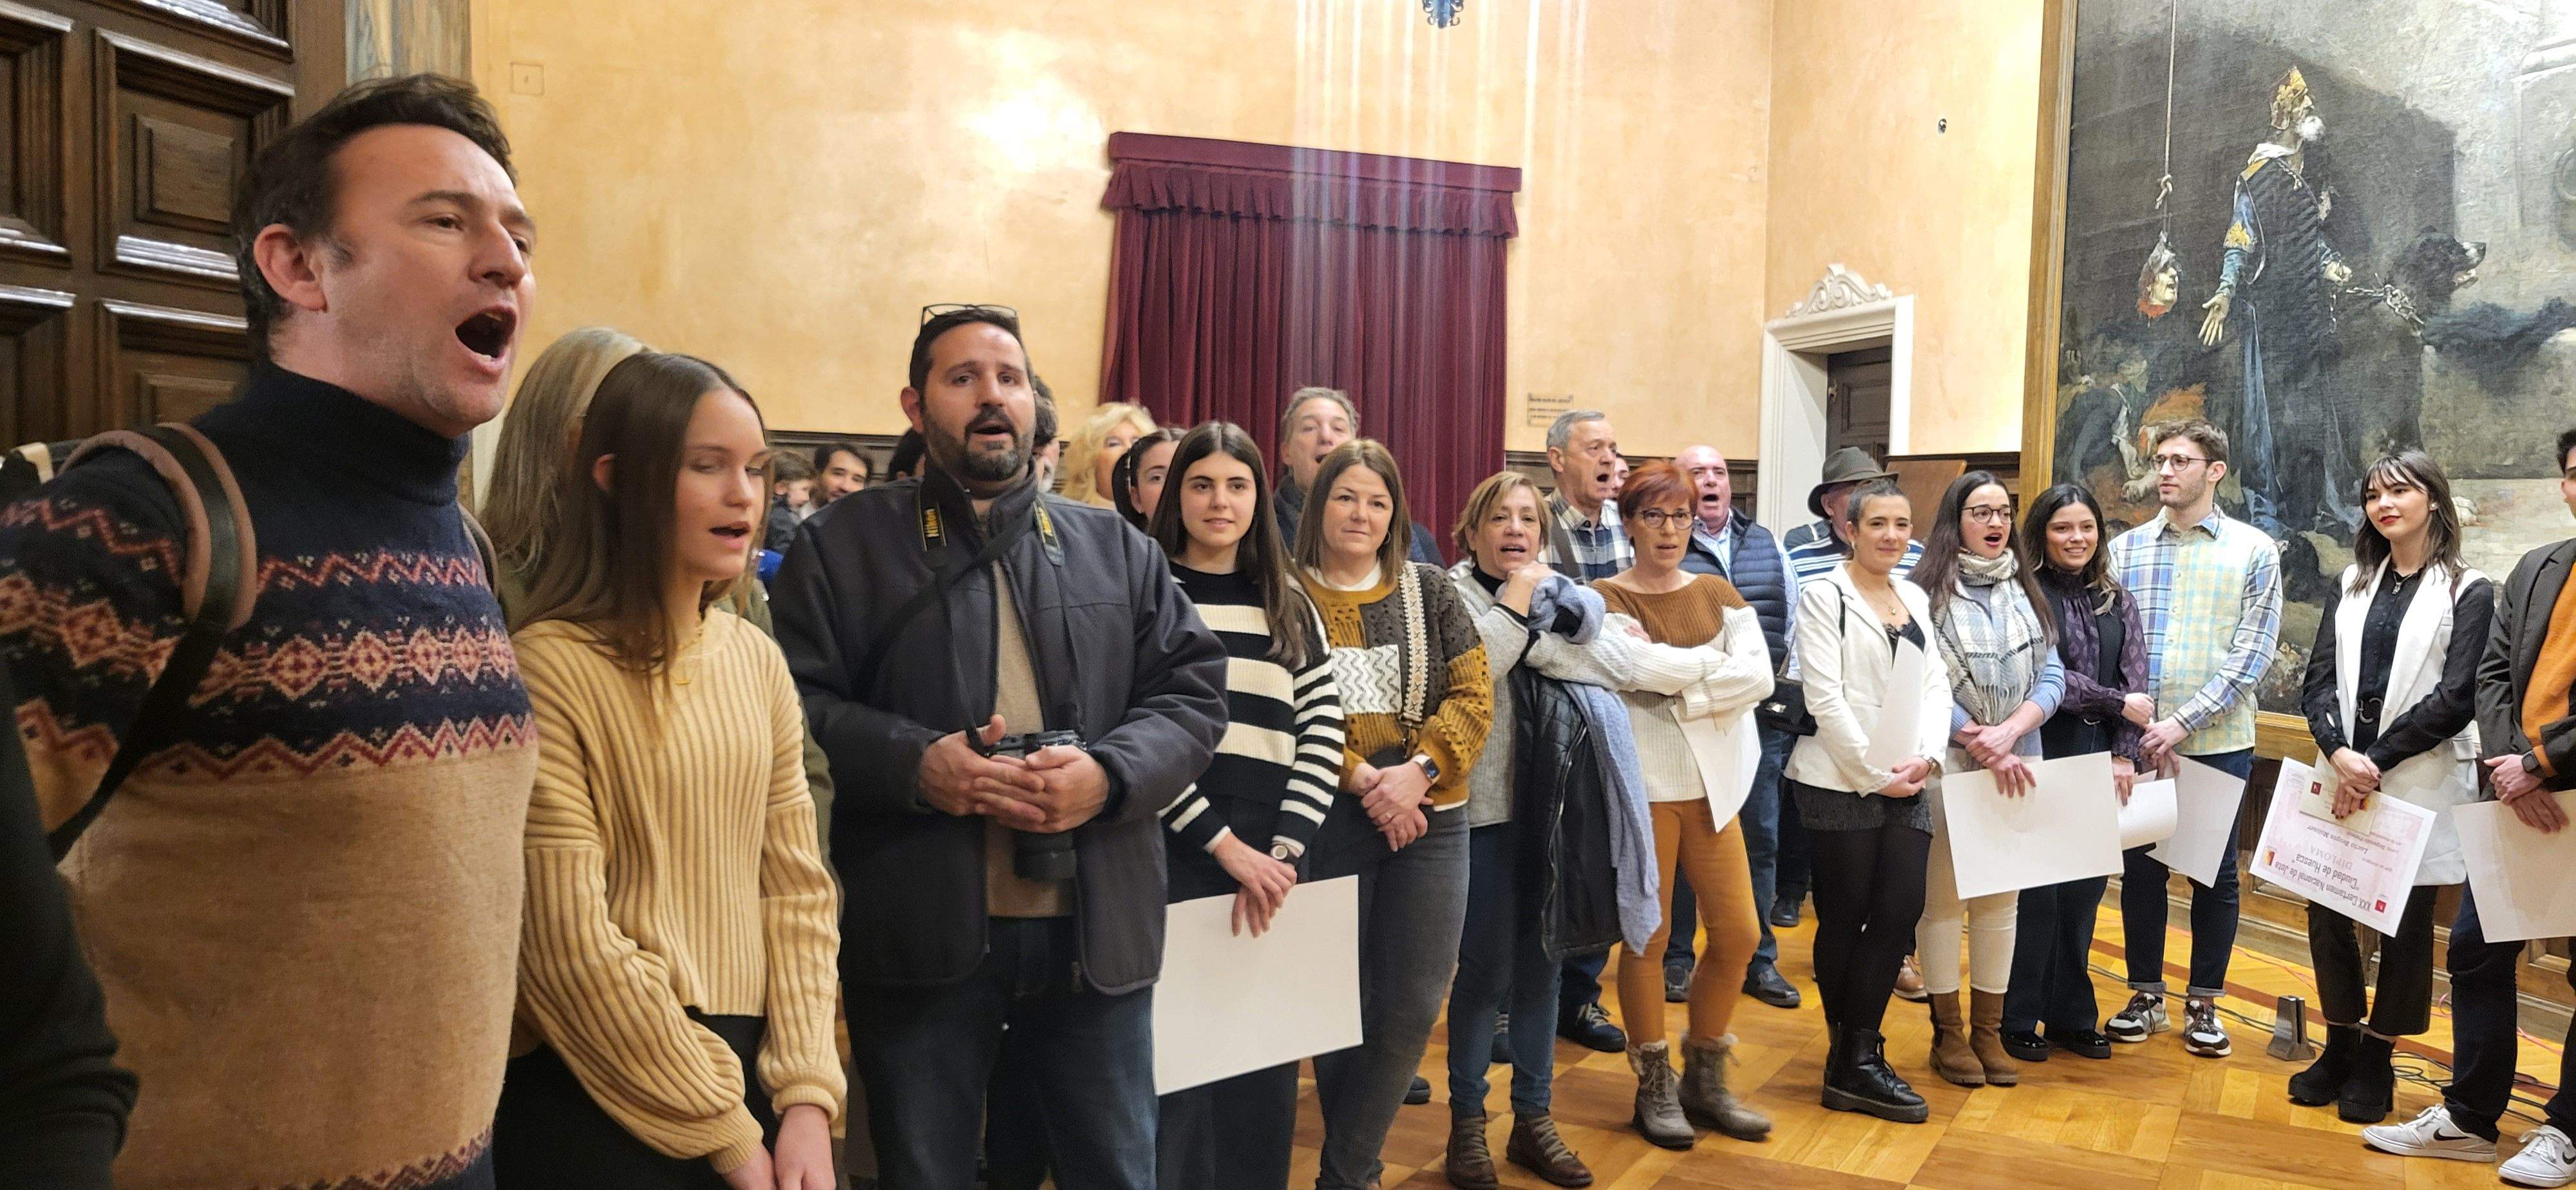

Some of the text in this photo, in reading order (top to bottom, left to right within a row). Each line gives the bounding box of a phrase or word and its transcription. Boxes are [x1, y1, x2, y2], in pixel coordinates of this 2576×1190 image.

[2308, 845, 2353, 871] DIPLOMA
[2273, 860, 2289, 874] Jota
[2288, 867, 2297, 879] de
[2321, 864, 2331, 878] de
[2297, 871, 2325, 891] Nacional
[2324, 883, 2358, 906] Certamen
